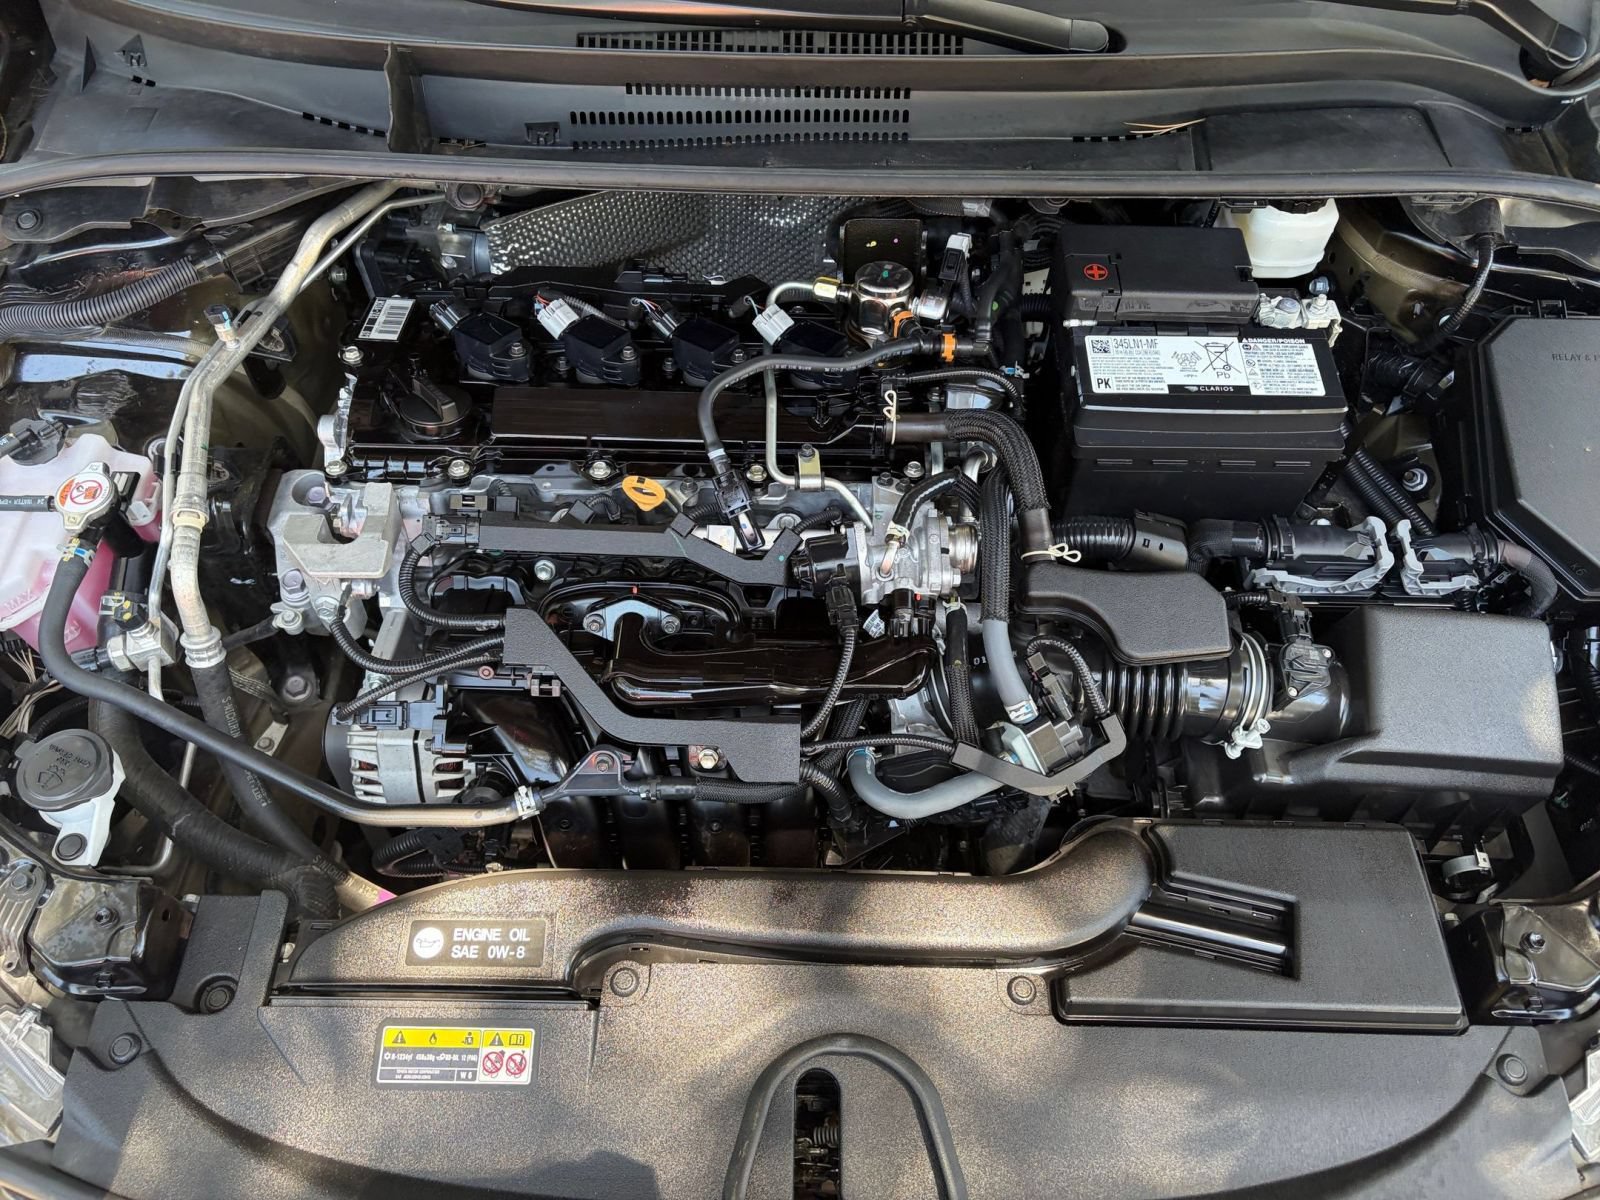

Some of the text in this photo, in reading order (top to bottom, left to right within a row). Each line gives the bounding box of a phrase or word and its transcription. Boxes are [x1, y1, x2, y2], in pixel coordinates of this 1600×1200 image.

[1114, 339, 1159, 349] 345LN1-MF
[1552, 353, 1581, 361] RELAY
[1216, 371, 1231, 379] Pb
[1097, 377, 1111, 389] PK
[4, 588, 34, 611] MAX
[453, 928, 530, 942] ENGINE OIL
[451, 945, 525, 958] SAE 0W-8
